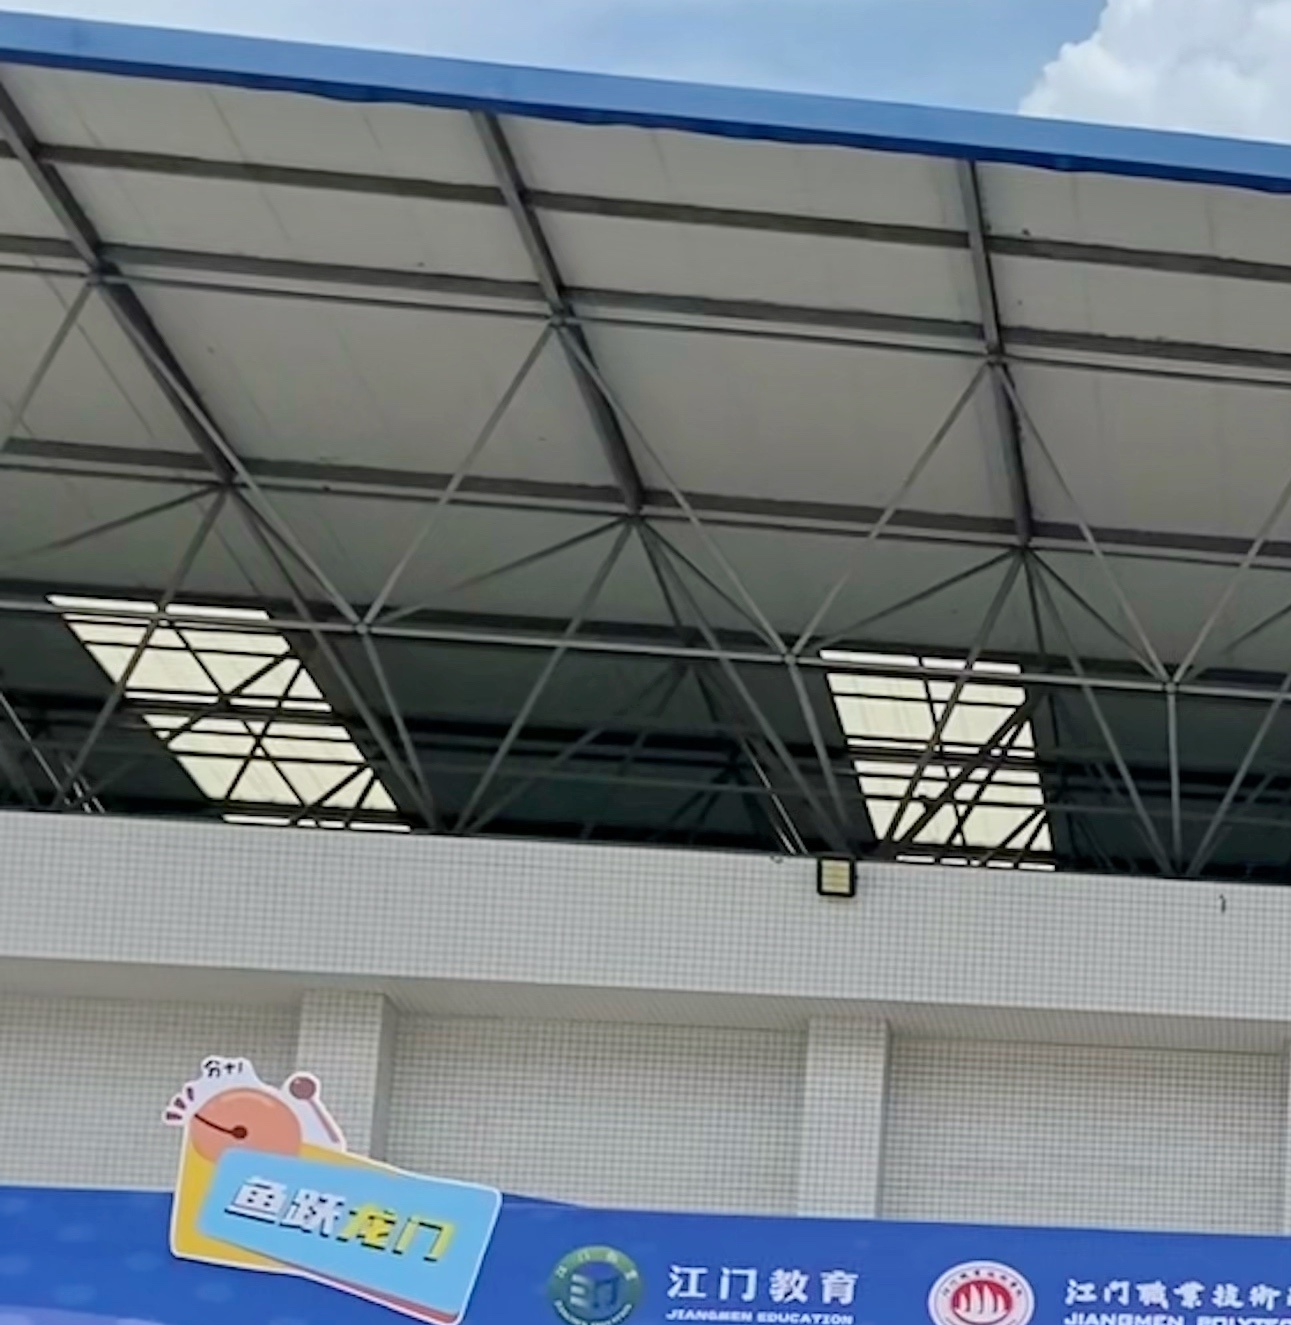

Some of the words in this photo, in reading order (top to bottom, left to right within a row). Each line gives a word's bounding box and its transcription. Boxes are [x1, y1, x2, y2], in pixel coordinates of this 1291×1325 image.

[225, 1176, 454, 1262] 鱼跃龙门
[667, 1264, 859, 1305] 江门教育
[666, 1309, 752, 1323] JIANGMEN
[757, 1311, 854, 1325] EDUCATION
